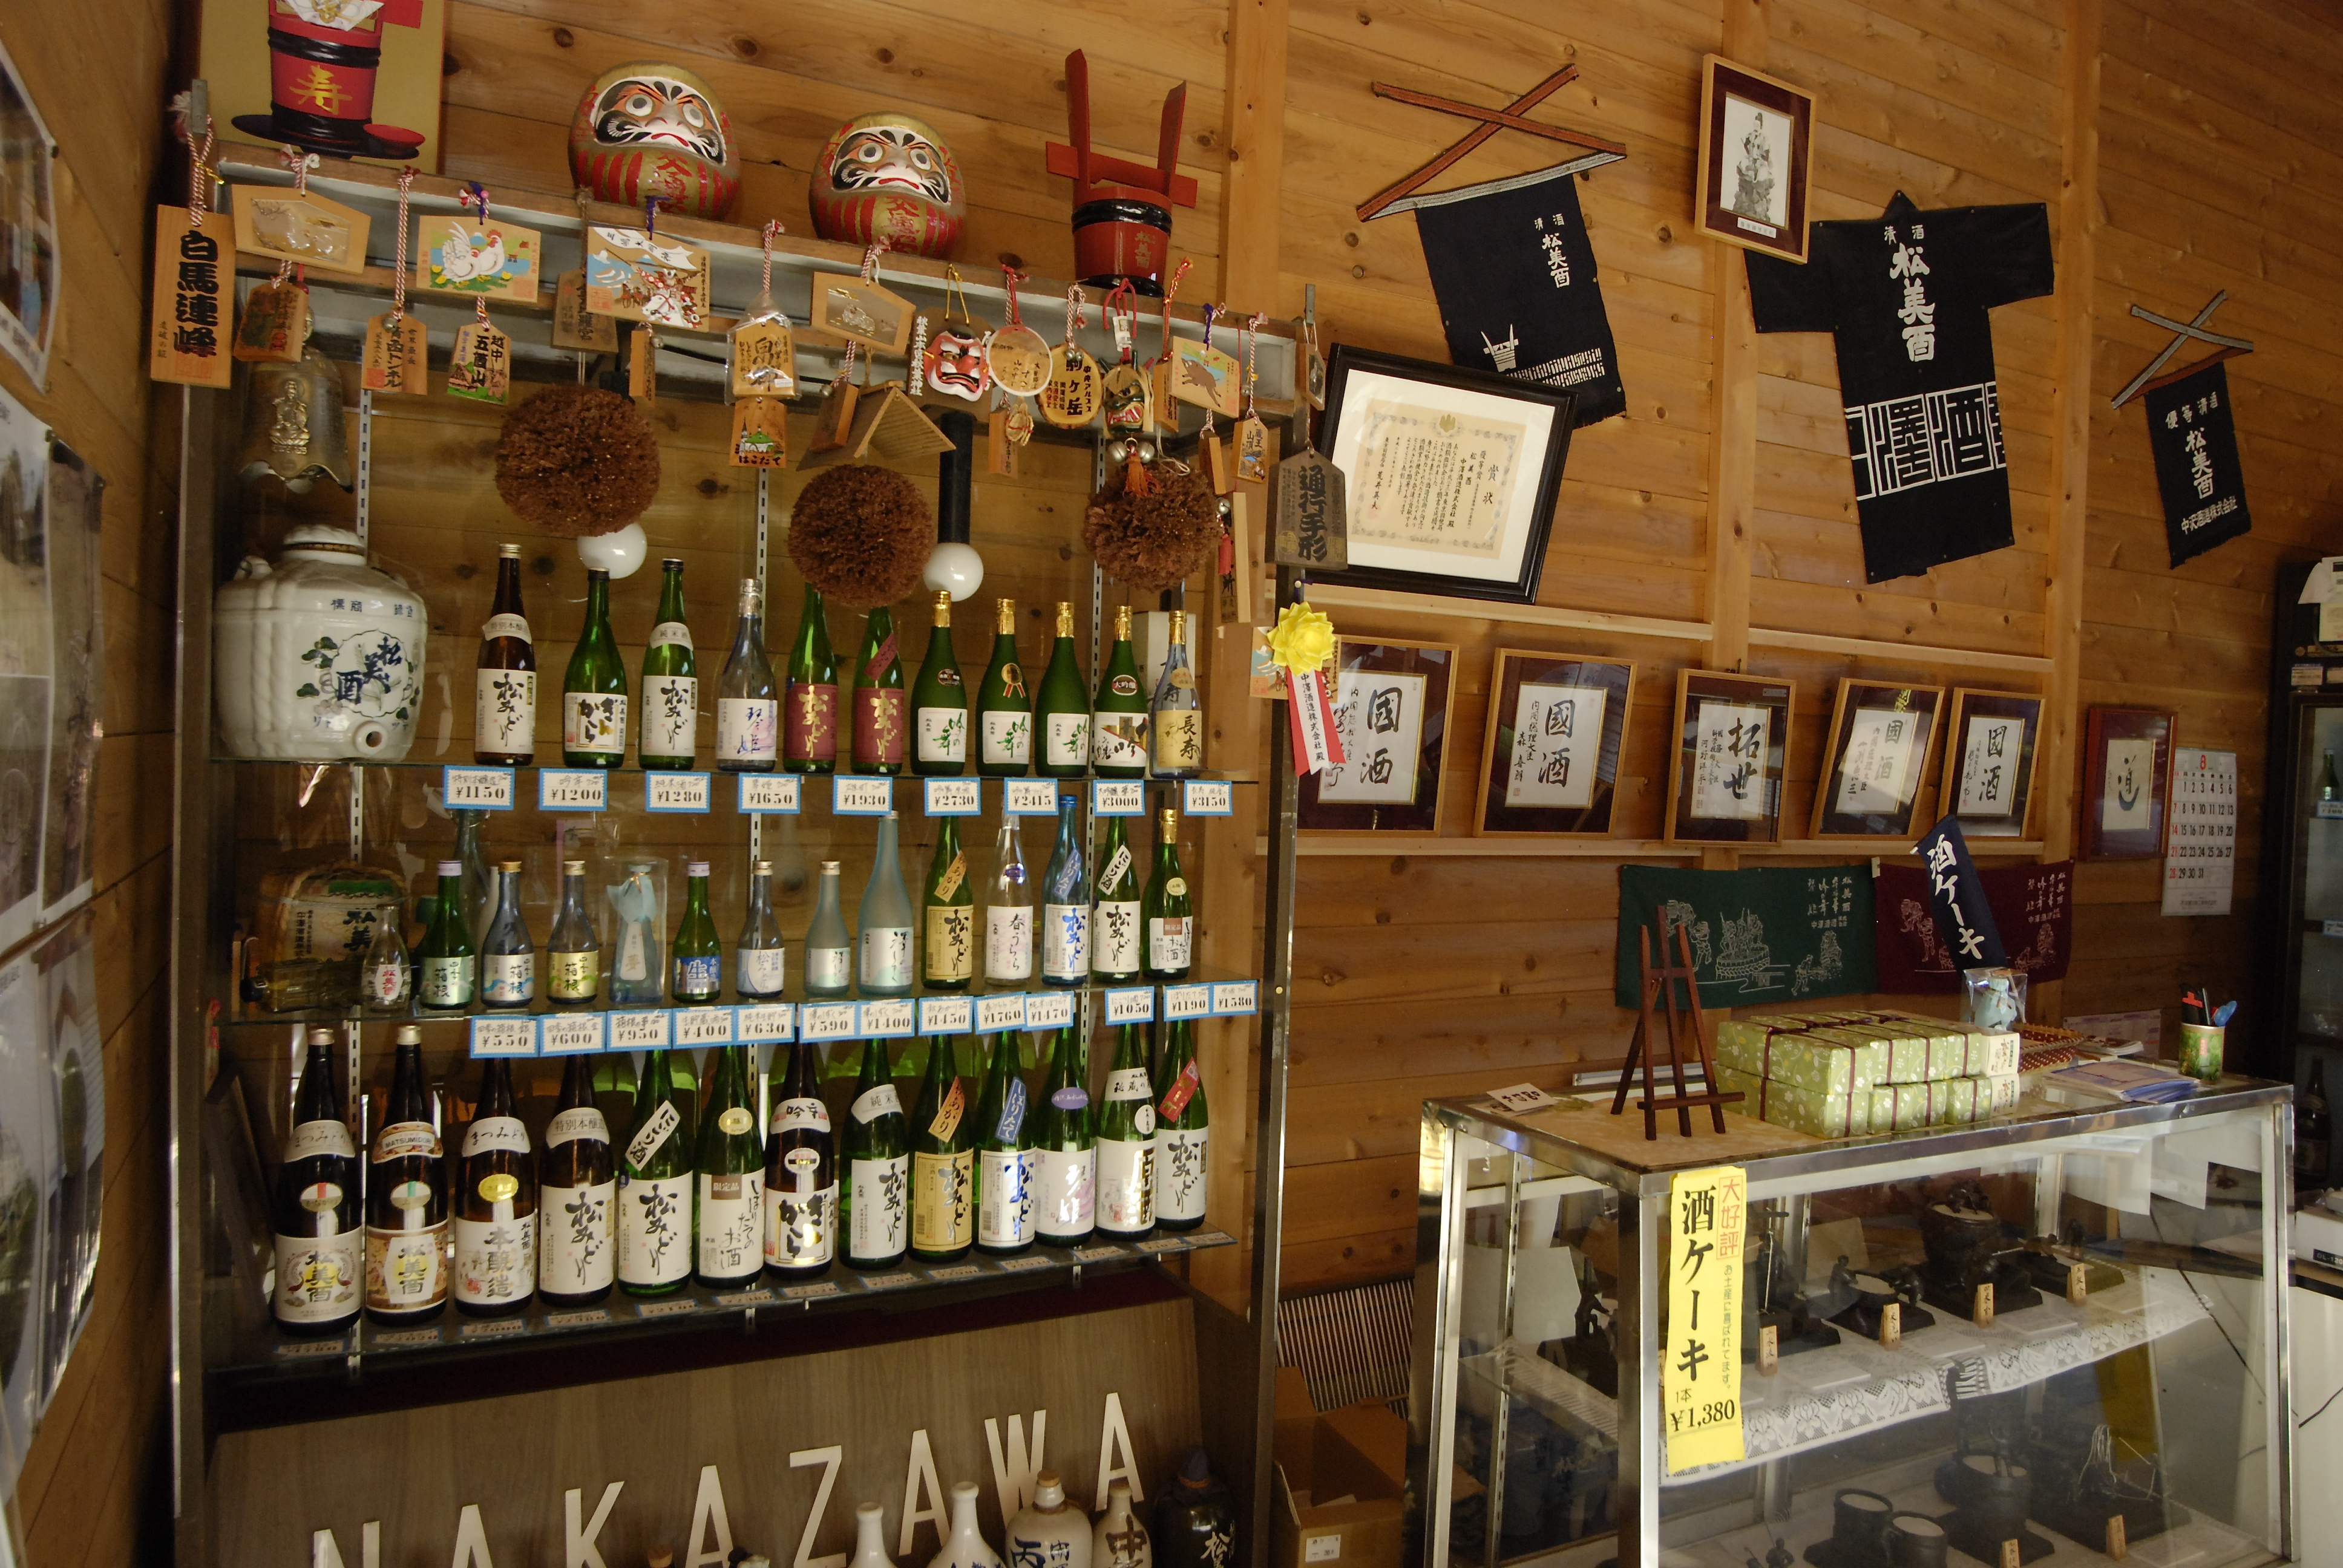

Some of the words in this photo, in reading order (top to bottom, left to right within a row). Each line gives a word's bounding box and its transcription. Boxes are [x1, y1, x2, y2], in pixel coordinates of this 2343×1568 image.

[289, 65, 352, 116] 寿
[1535, 213, 1565, 230] 清酒
[1884, 225, 1925, 244] 清酒
[491, 335, 505, 363] 越中
[739, 456, 781, 466] はこだて
[1300, 673, 1323, 749] 中澤酒造株式会社
[1538, 699, 1576, 788] 國酒
[2200, 754, 2207, 770] 8
[456, 786, 505, 800] ¥1150
[551, 788, 601, 801] ¥1200
[657, 791, 703, 803] ¥1280
[750, 792, 793, 804] ¥1650
[844, 794, 886, 806] ¥1930
[935, 795, 975, 806] ¥2730
[1014, 795, 1052, 806] ¥2415
[1103, 797, 1138, 807] ¥3000
[1193, 796, 1226, 807] ¥3150
[2199, 803, 2206, 815] 10
[2209, 804, 2215, 815] 11
[2218, 804, 2224, 815] 12
[2227, 805, 2233, 815] 13
[2172, 825, 2178, 835] 14
[2181, 825, 2187, 836] 15
[2189, 825, 2196, 836] 16
[2199, 825, 2205, 836] 17
[2208, 825, 2214, 836] 18
[2217, 825, 2224, 837] 19
[2226, 826, 2233, 837] 20
[2171, 846, 2178, 857] 21
[2179, 846, 2187, 857] 22
[2189, 846, 2196, 857] 23
[2198, 846, 2205, 857] 24
[2207, 846, 2214, 857] 25
[2216, 847, 2223, 858] 26
[2225, 847, 2232, 858] 27
[2169, 867, 2177, 879] 28
[2178, 867, 2186, 879] 29
[2187, 867, 2195, 879] 30
[2198, 867, 2204, 879] 31
[1928, 832, 1985, 959] 酒ケーキ
[1172, 1000, 1206, 1012] ¥1190
[1218, 996, 1252, 1008] ¥1580
[1032, 1008, 1068, 1021] ¥1470
[1114, 1004, 1150, 1016] ¥1050
[867, 1017, 911, 1030] ¥1400
[928, 1013, 966, 1025] ¥1450
[984, 1010, 1021, 1024] ¥1760
[684, 1025, 727, 1039] ¥400
[746, 1023, 785, 1035] ¥630
[810, 1020, 848, 1033] ¥590
[483, 1034, 528, 1047] ¥550
[551, 1032, 592, 1045] ¥600
[618, 1028, 658, 1040] ¥950
[384, 1136, 433, 1149] MATSUMIDORI
[629, 1108, 675, 1164] にごり酒
[1720, 1178, 1741, 1258] 大好評
[639, 1183, 678, 1275] 松みどり
[565, 1191, 605, 1285] 松みどり
[484, 1226, 514, 1298] 本醸造
[1677, 1185, 1717, 1382] 酒ケーキ
[1670, 1399, 1735, 1432] ¥1,380
